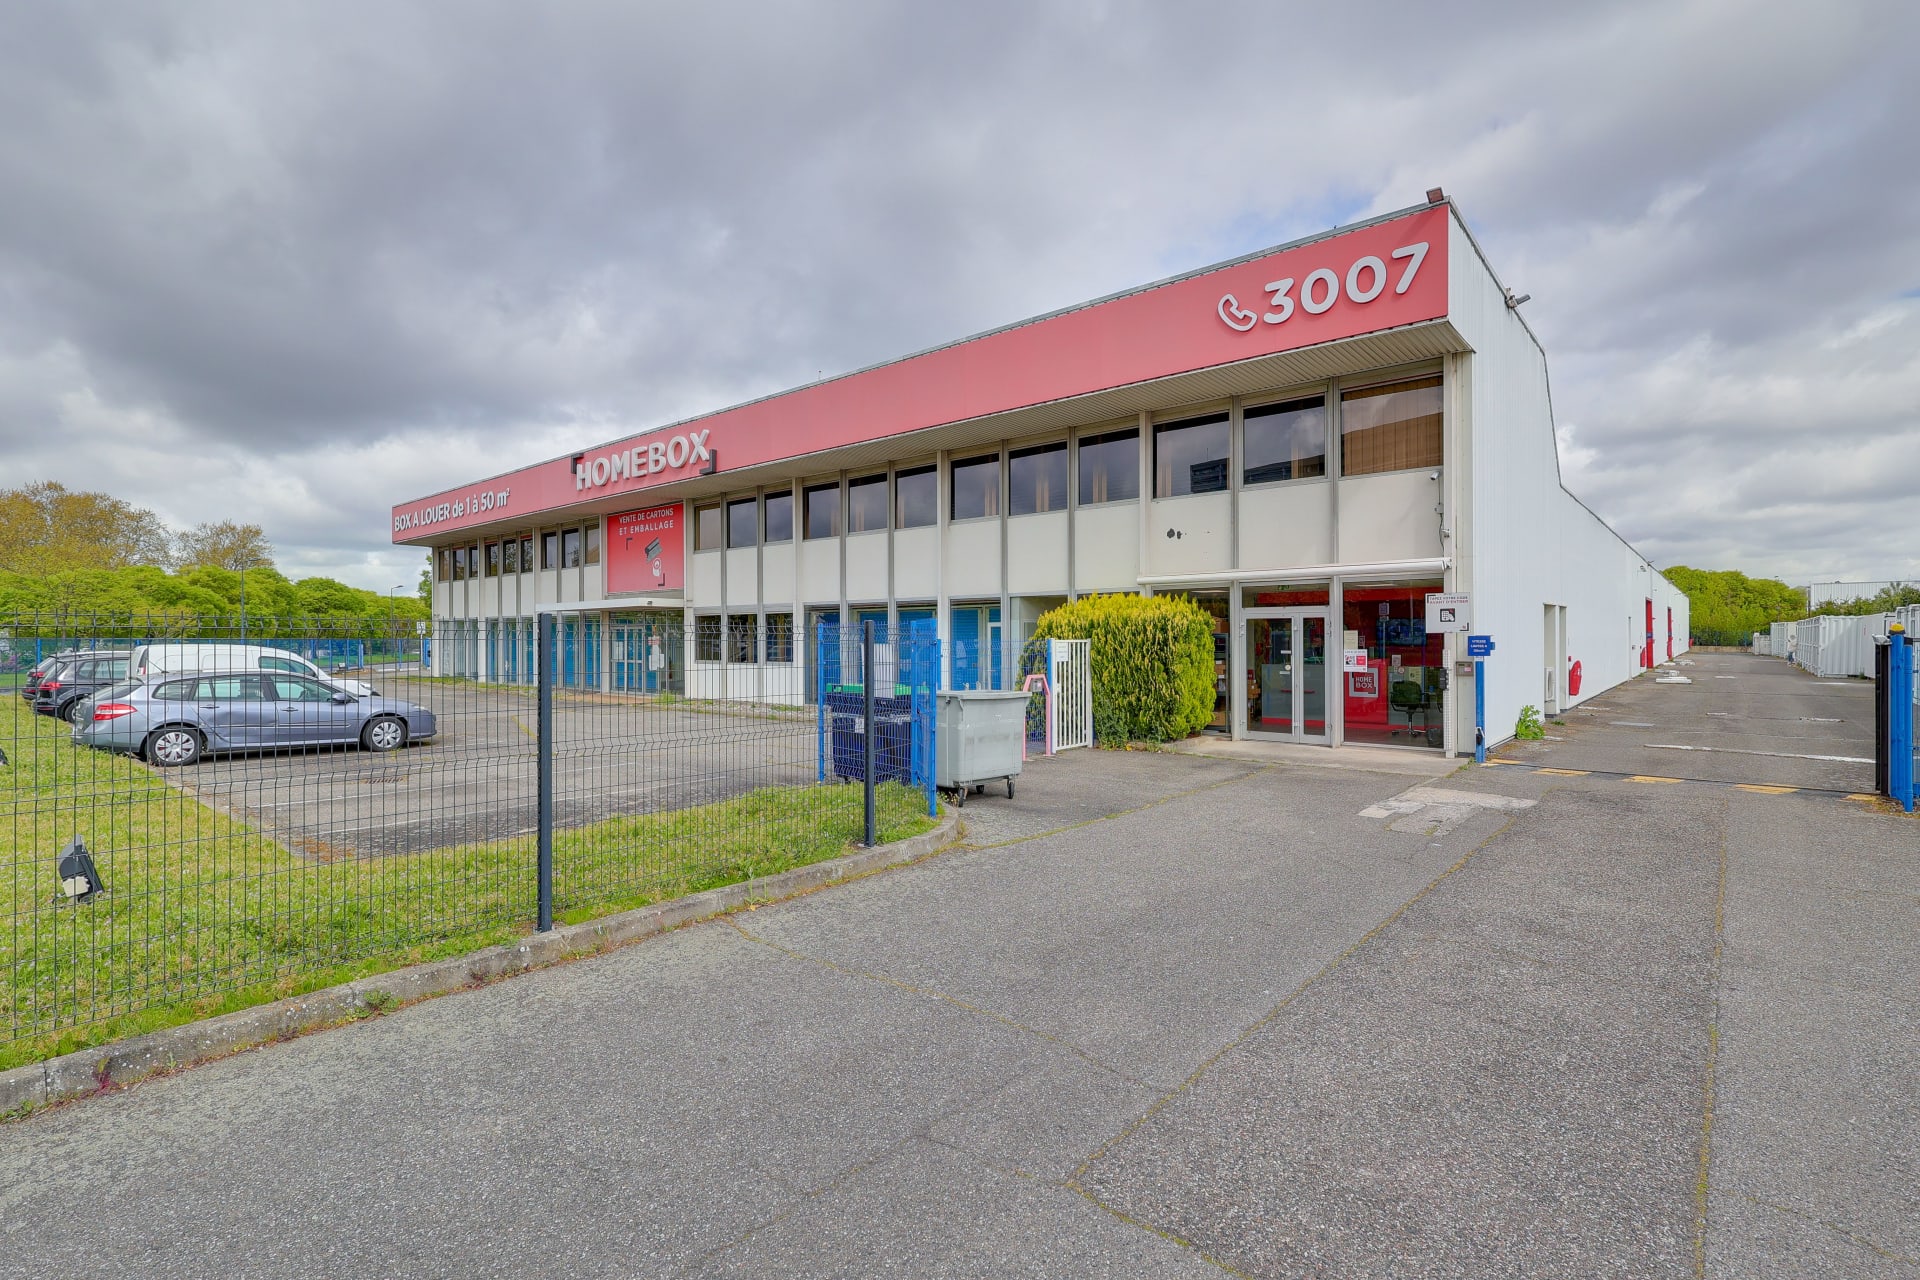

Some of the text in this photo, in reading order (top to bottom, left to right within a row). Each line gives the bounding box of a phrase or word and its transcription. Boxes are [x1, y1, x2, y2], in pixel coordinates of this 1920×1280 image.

[1263, 241, 1430, 324] 3007
[576, 429, 710, 491] HOMEBOX
[394, 511, 412, 532] BOX
[412, 513, 419, 528] A
[420, 502, 450, 526] LOUER
[452, 499, 464, 518] de
[465, 496, 470, 514] 1
[472, 494, 479, 513] à
[481, 491, 495, 512] 50
[619, 508, 674, 524] VENTE DE CARTONS
[619, 520, 674, 536] ET EMBALLAGE
